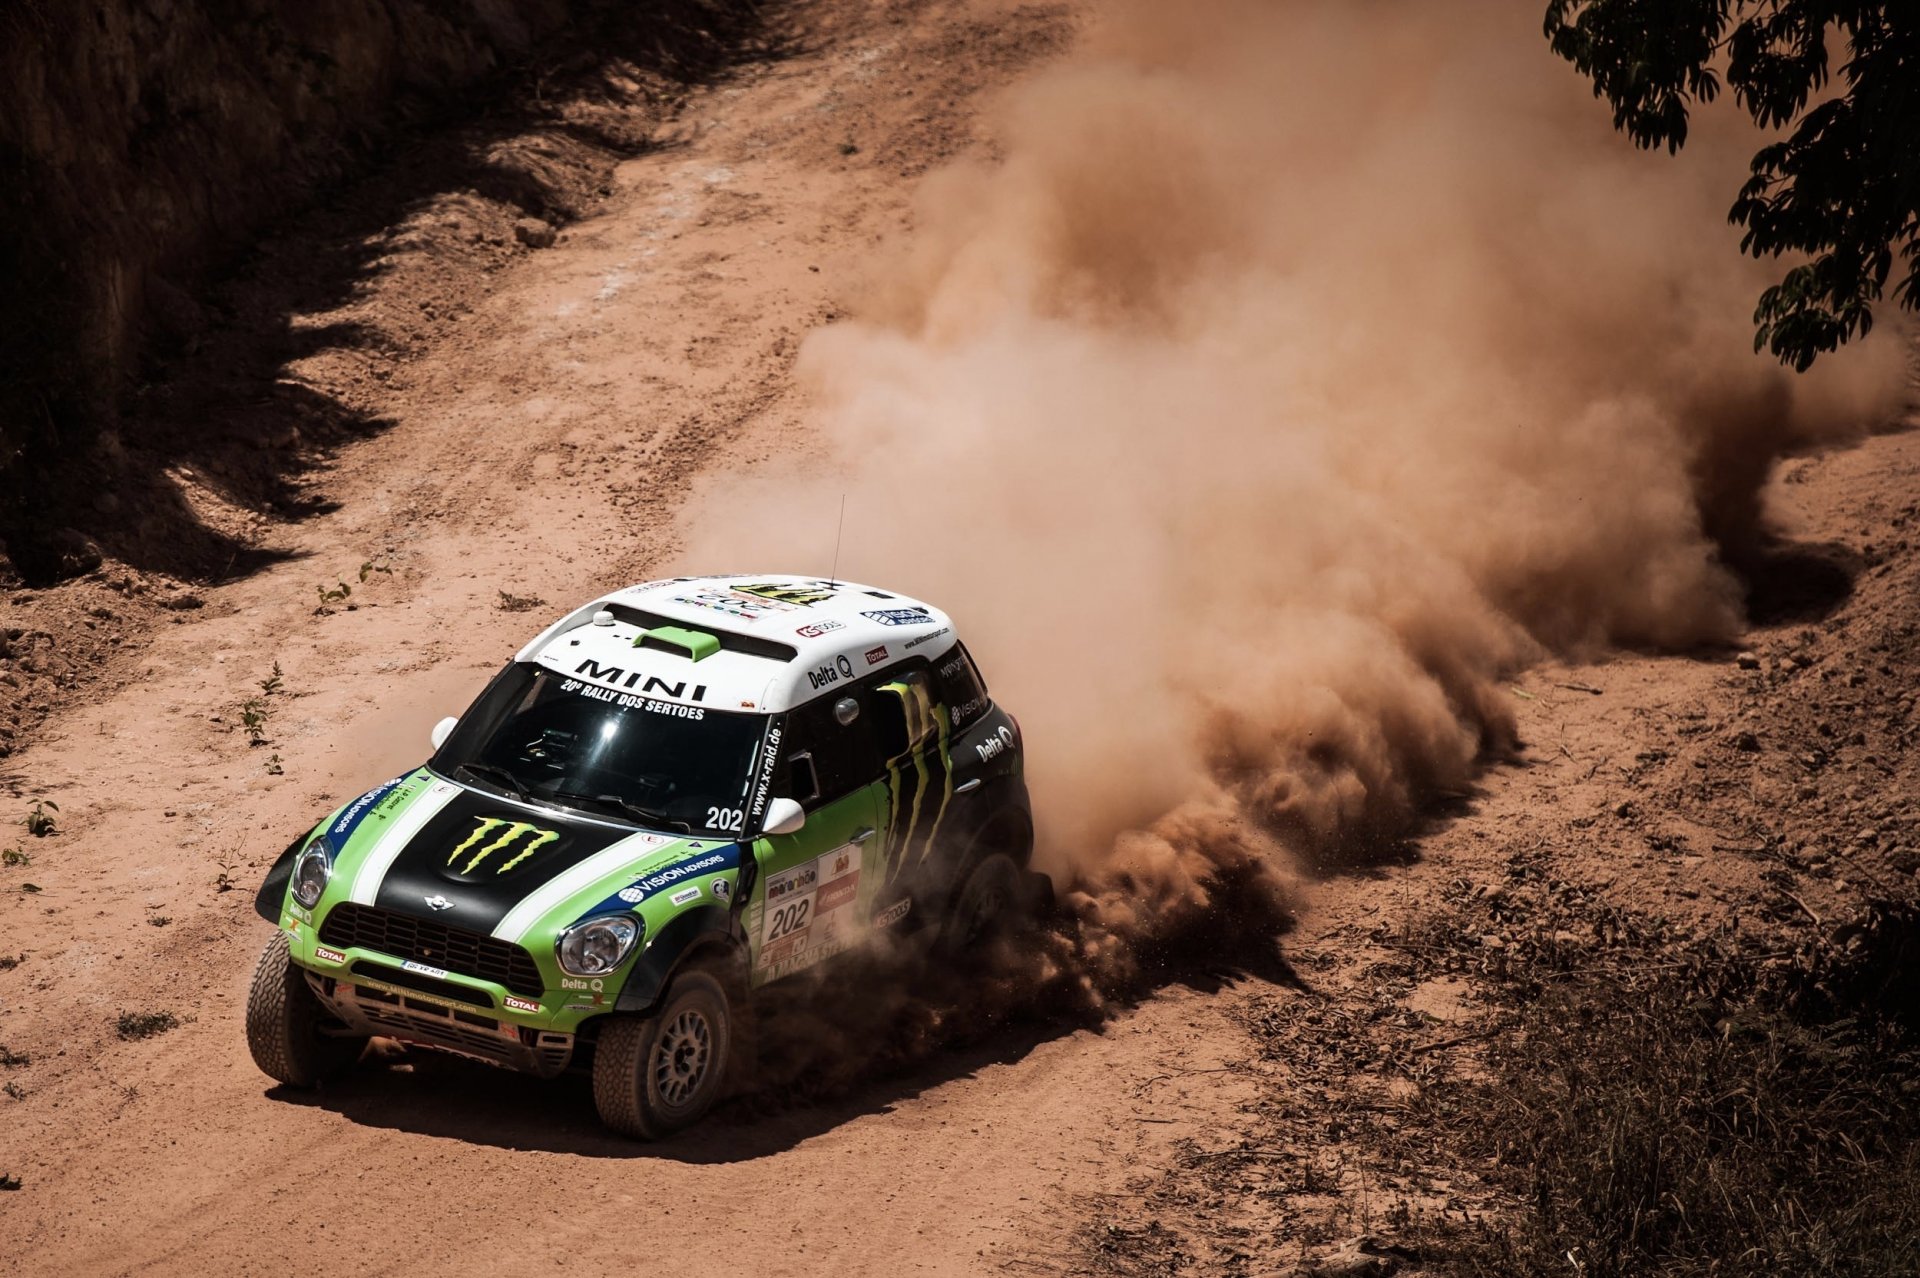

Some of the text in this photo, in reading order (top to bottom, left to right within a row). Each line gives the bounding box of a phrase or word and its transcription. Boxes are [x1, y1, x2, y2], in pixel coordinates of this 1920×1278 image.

[867, 651, 888, 663] TOTAL
[574, 658, 707, 702] MINI
[808, 662, 839, 690] Delta
[580, 684, 619, 703] RALLY
[617, 694, 645, 708] DOS
[645, 701, 705, 721] SERTOES
[976, 737, 1004, 763] Delta
[752, 728, 782, 816] www.x-raid.de
[705, 806, 744, 832] 202
[634, 867, 686, 892] VISION
[684, 854, 725, 874] ADVISORS
[768, 898, 810, 942] 202
[316, 948, 345, 963] TOTAL
[367, 979, 478, 1014] www.MINImotorsport.com
[562, 978, 588, 990] Delta
[505, 997, 538, 1012] TOTAL
